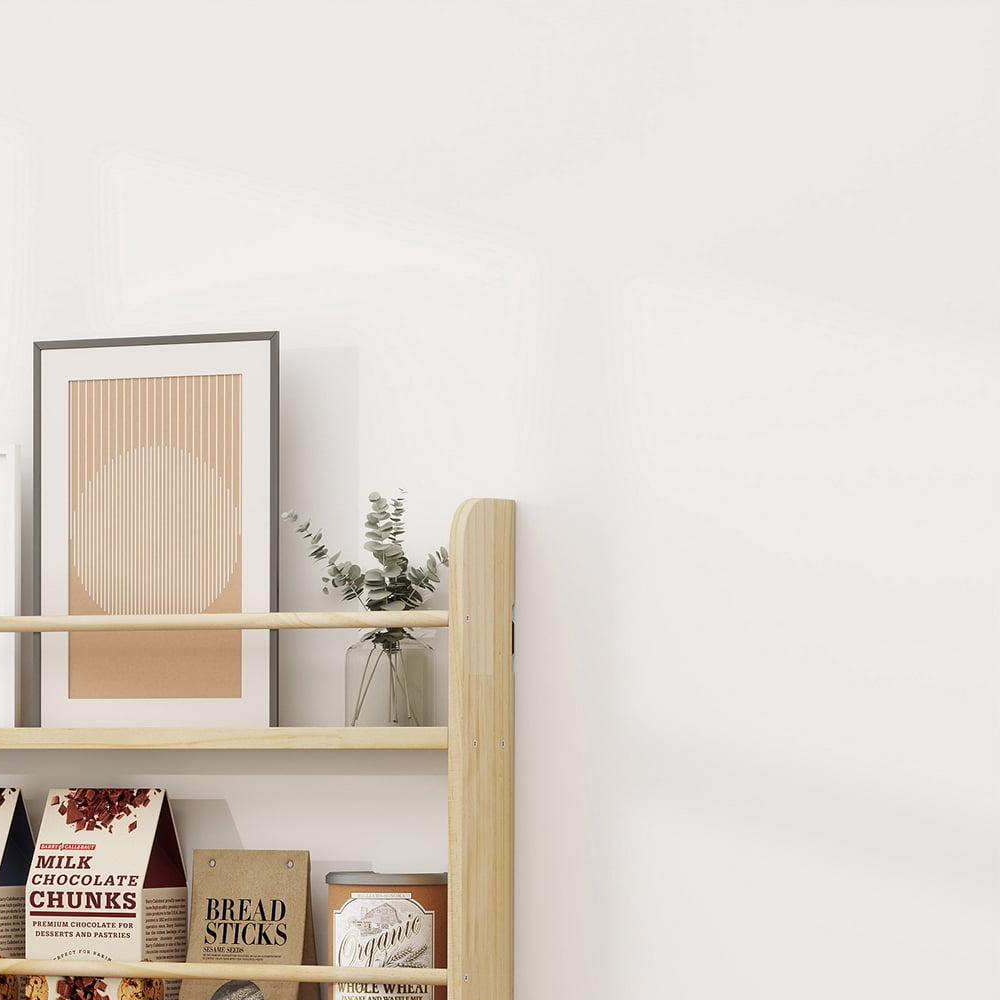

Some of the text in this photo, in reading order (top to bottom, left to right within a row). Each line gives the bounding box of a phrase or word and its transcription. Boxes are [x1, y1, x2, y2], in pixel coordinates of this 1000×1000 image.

[35, 855, 94, 870] MILK
[31, 874, 140, 887] CHOCOLATE
[29, 890, 137, 910] CHUNKS
[204, 897, 287, 922] BREAD
[70, 921, 117, 929] CHOCOLATE
[204, 921, 288, 947] STICKS
[339, 913, 421, 968] Organic
[337, 983, 380, 994] WHOLE
